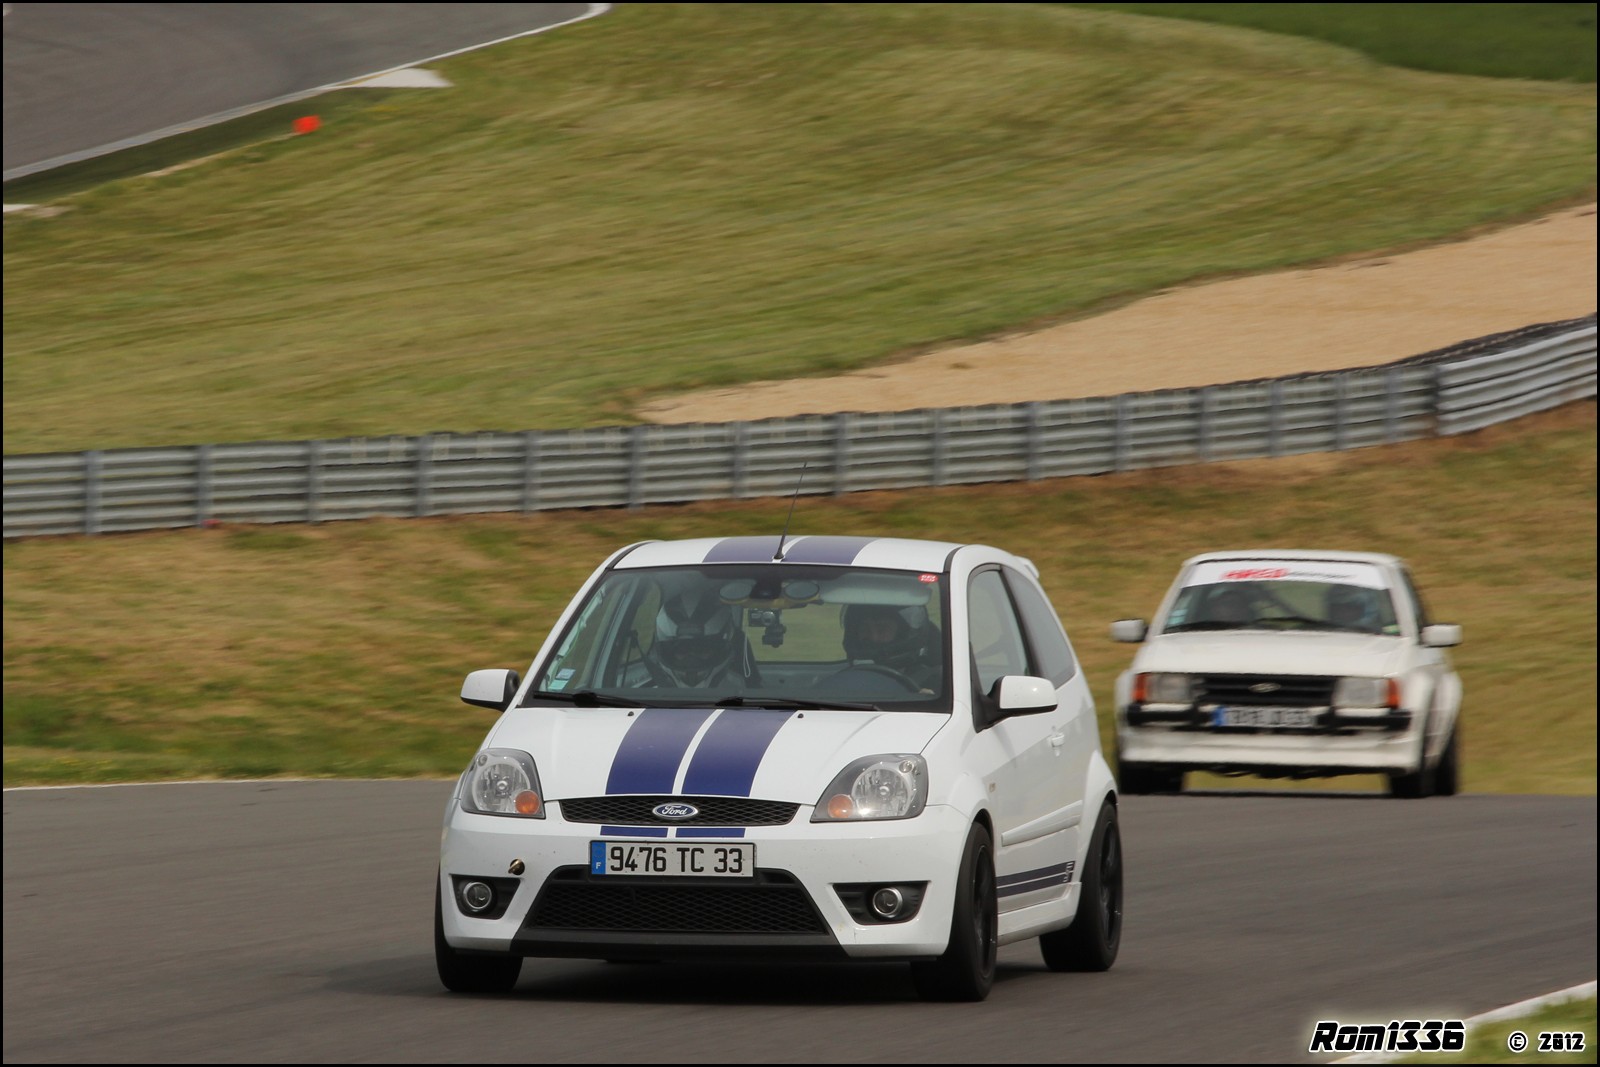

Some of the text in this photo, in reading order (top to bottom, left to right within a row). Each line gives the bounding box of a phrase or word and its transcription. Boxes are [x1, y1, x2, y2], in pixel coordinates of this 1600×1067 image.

[660, 804, 690, 816] Ford
[610, 846, 667, 872] 9476
[676, 847, 704, 873] TC
[713, 848, 743, 873] 33
